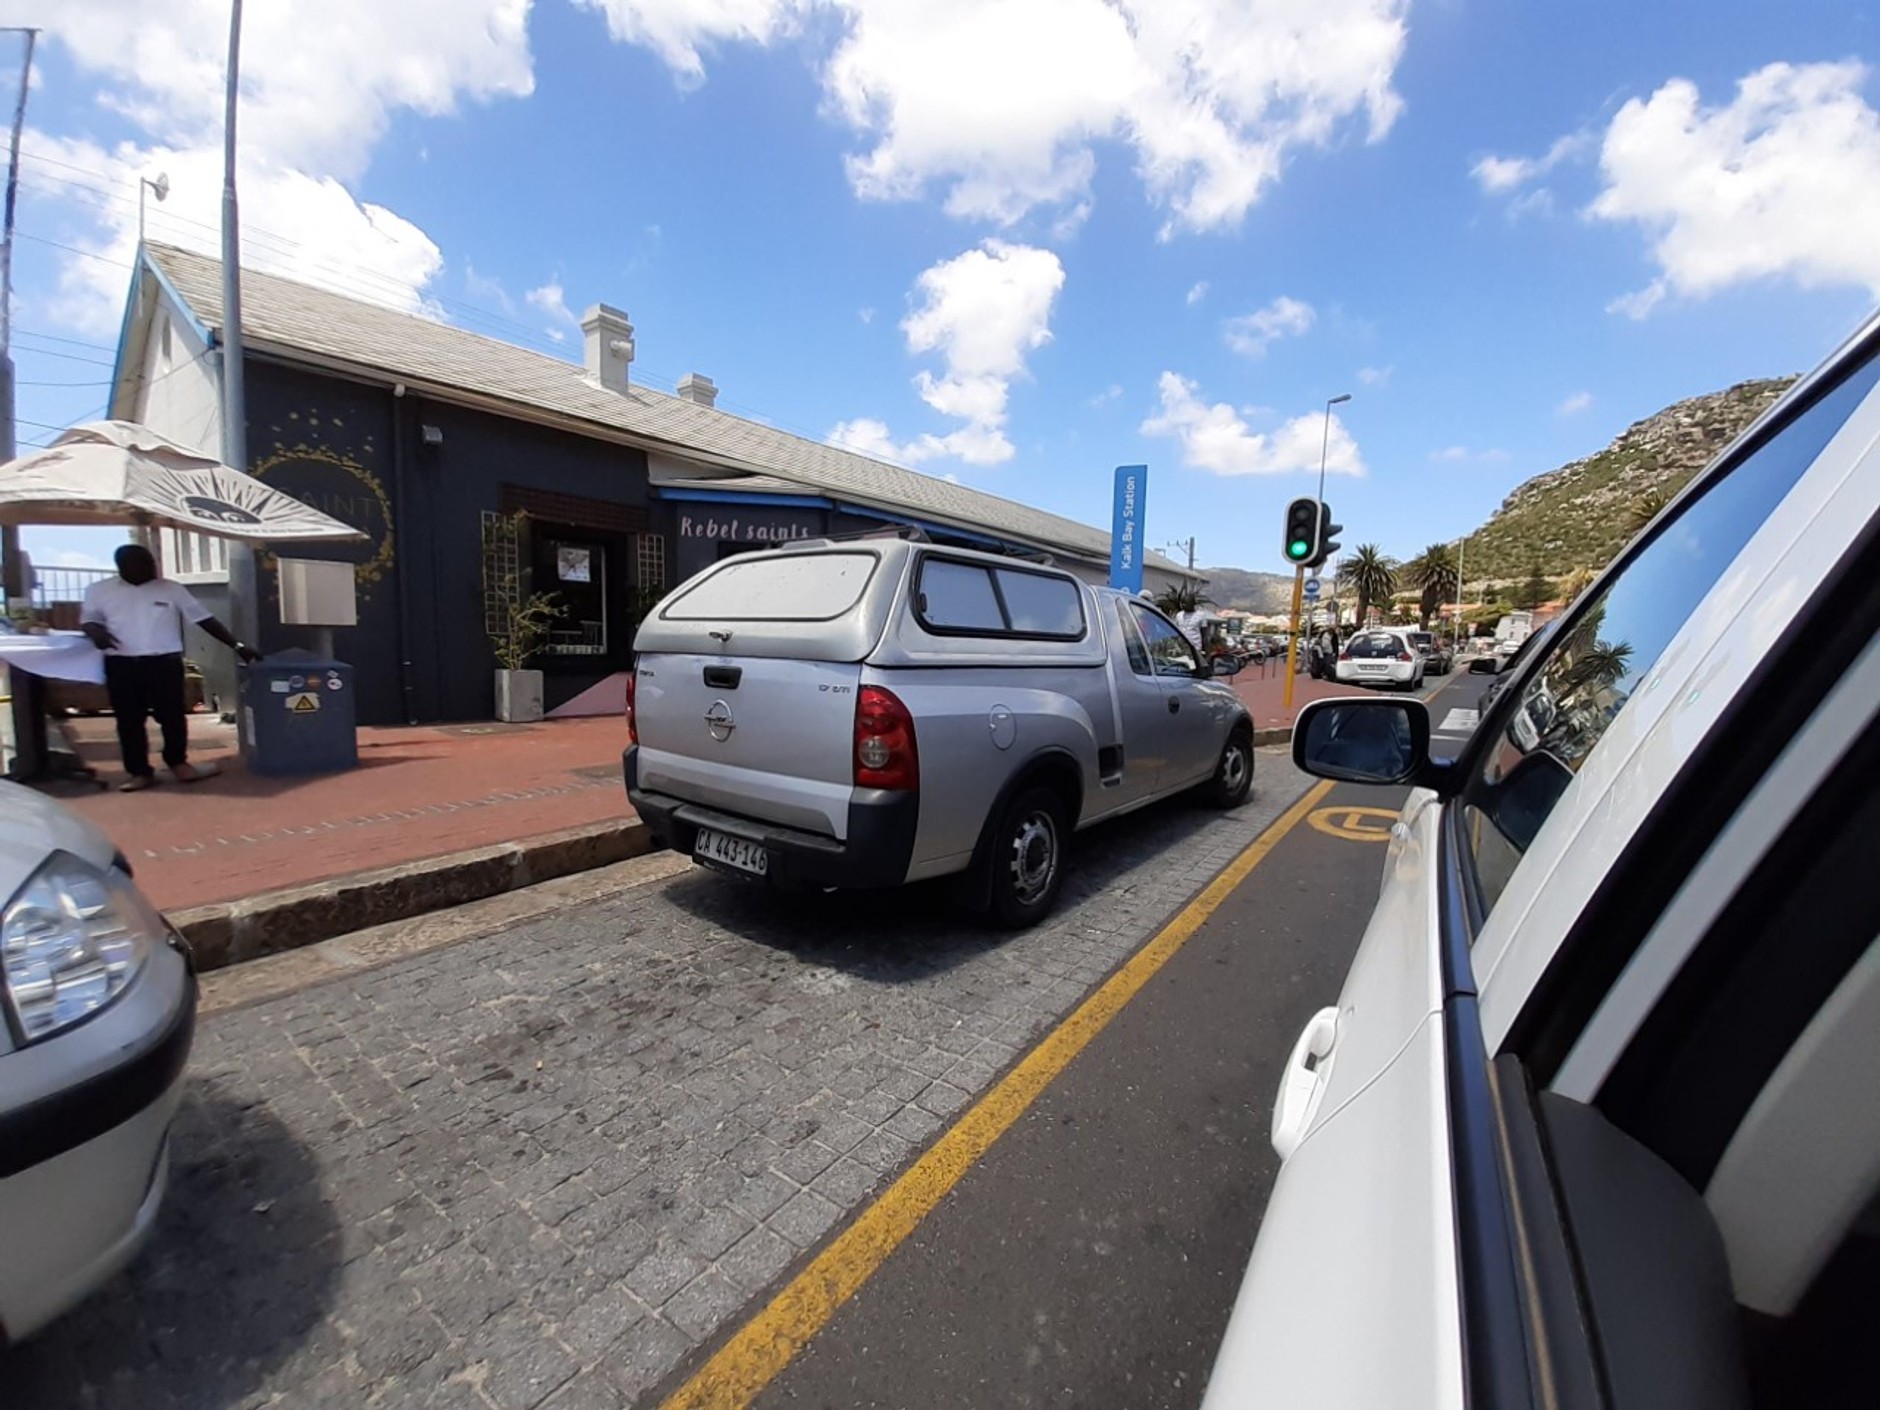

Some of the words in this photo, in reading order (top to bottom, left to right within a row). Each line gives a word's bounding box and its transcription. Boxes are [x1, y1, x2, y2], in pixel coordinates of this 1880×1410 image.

[278, 487, 377, 518] AINT
[1122, 475, 1136, 519] Station
[681, 516, 739, 540] Rebel
[1122, 520, 1135, 542] Bay
[1121, 543, 1133, 570] Kalk
[697, 829, 711, 853] CA
